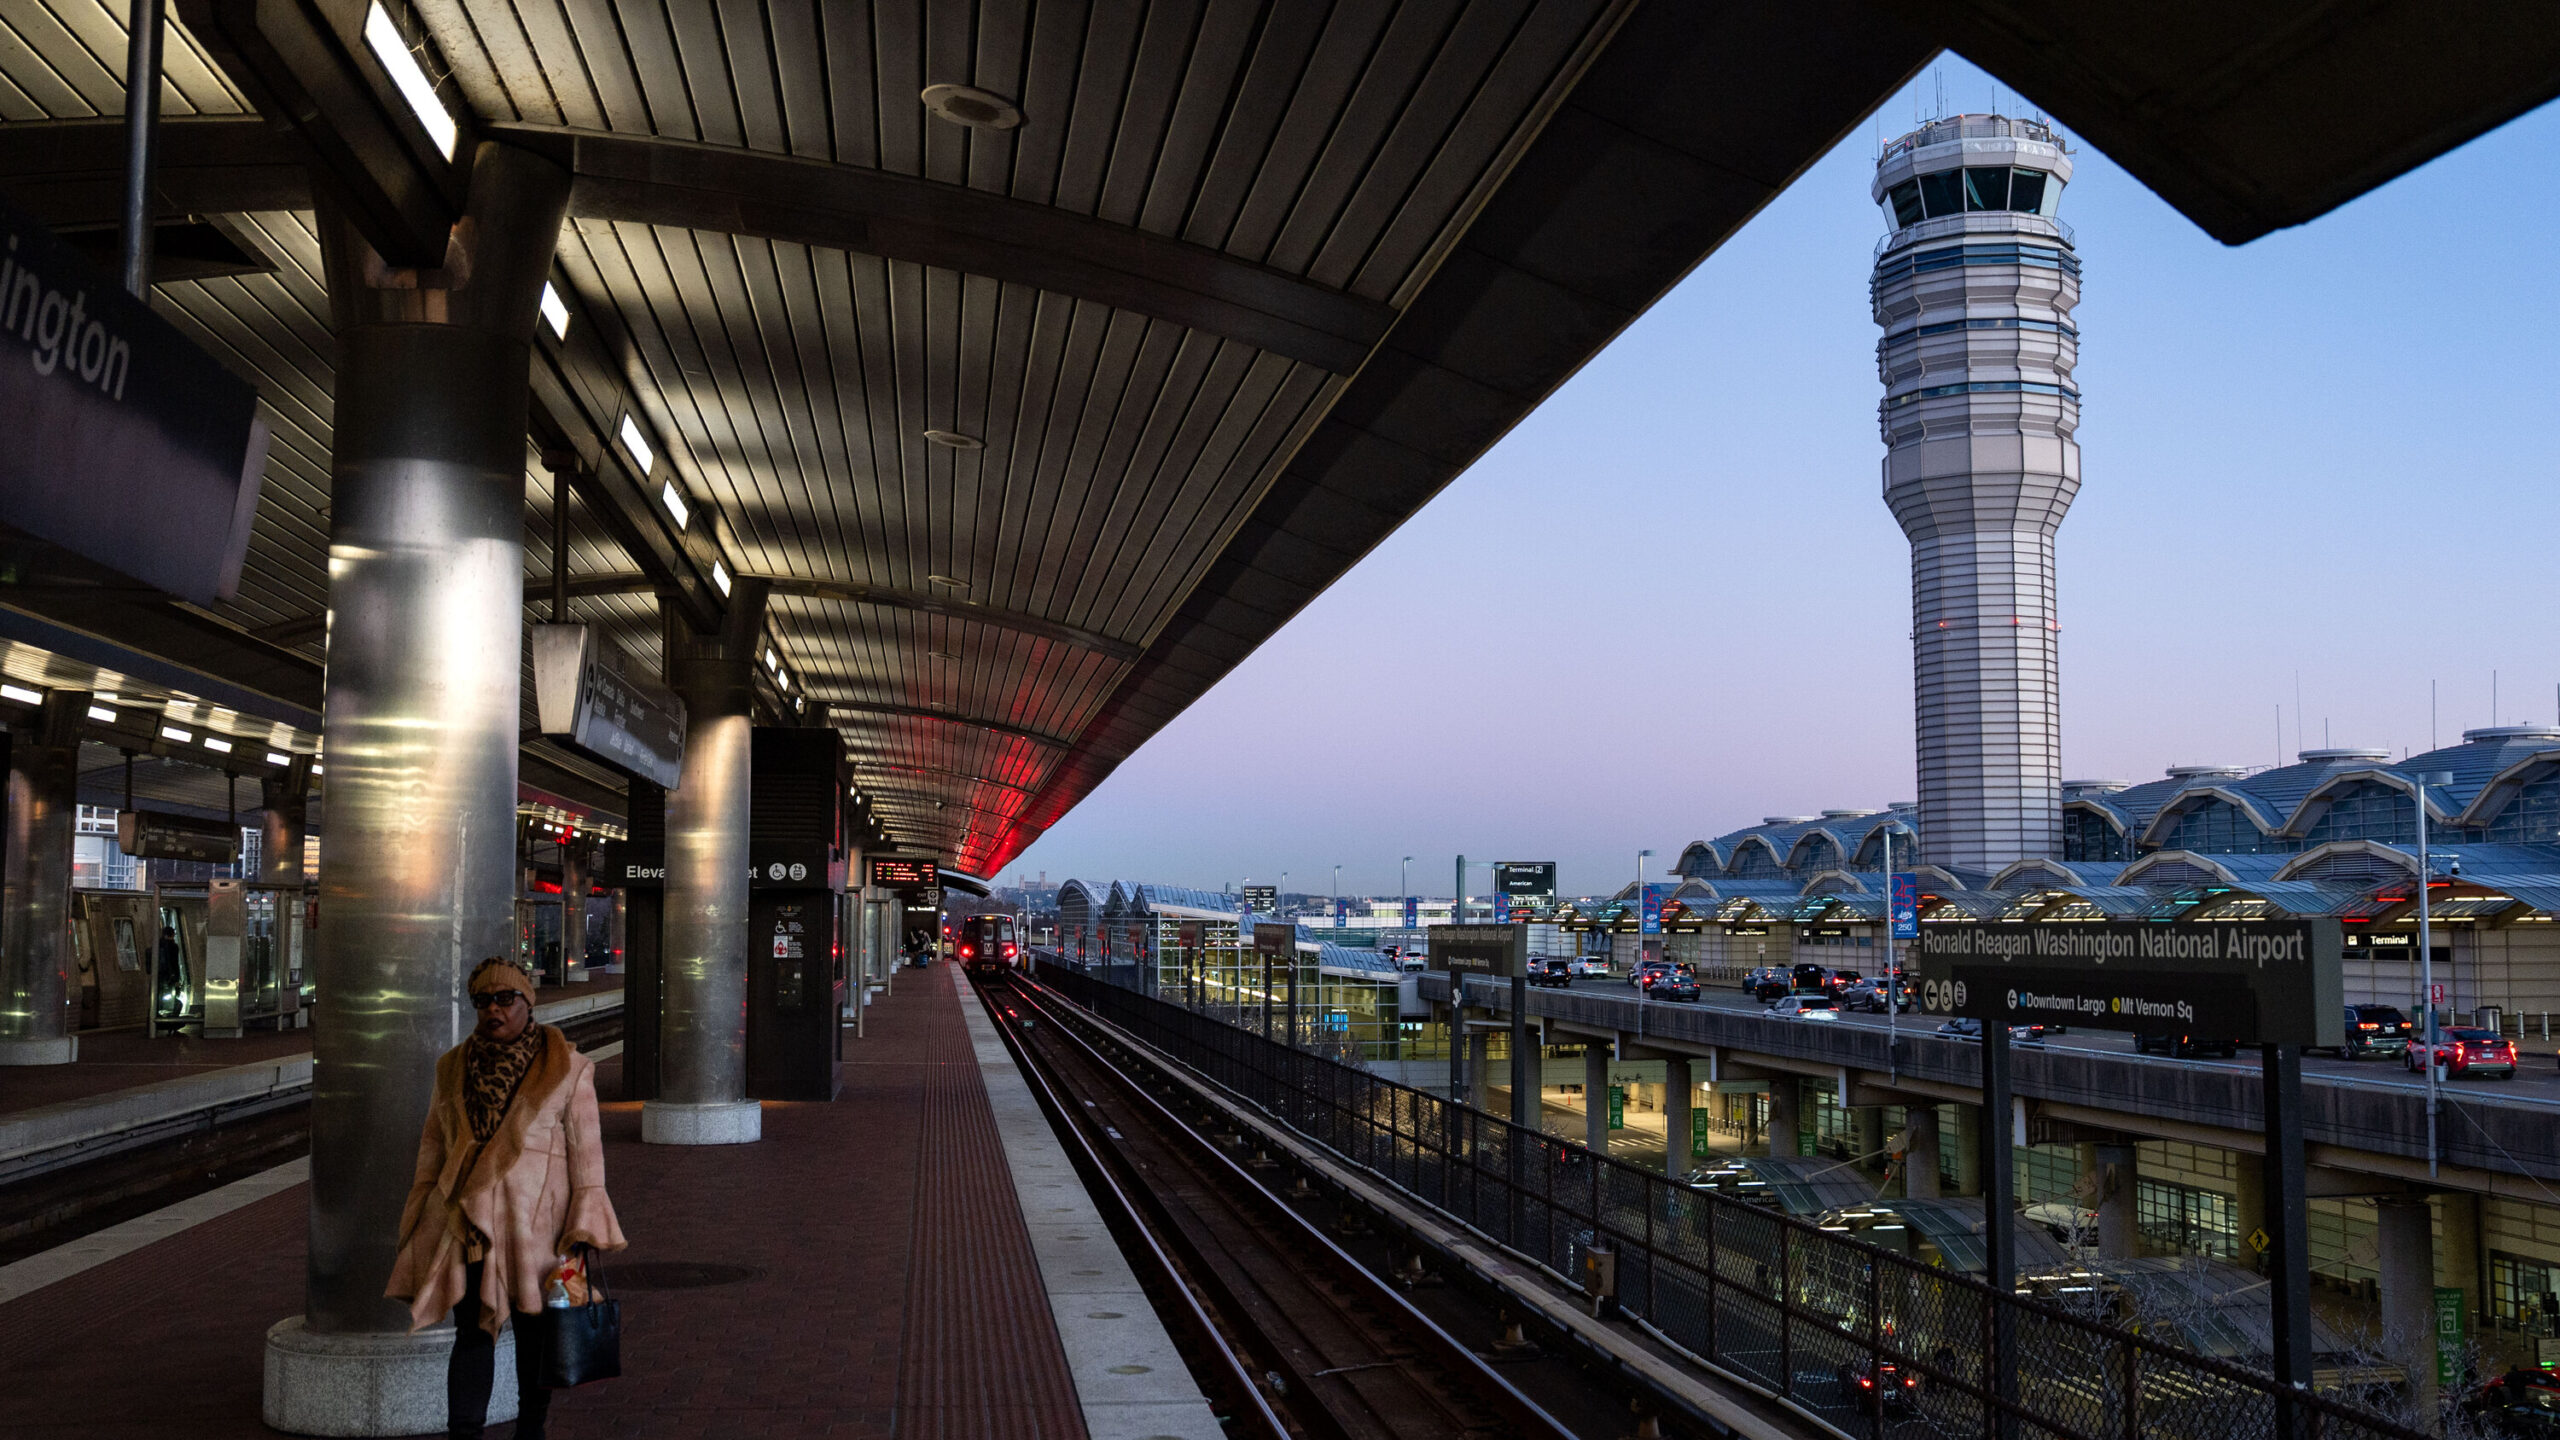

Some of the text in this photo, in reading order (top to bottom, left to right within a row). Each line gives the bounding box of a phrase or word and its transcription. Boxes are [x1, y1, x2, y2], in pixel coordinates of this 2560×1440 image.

[1897, 923, 1913, 931] 250
[2370, 934, 2409, 945] Terminal
[1924, 927, 2304, 969] Ronald Reagan Washington National Airport
[2026, 992, 2075, 1011] Downtown
[2077, 994, 2106, 1017] Largo
[2121, 997, 2134, 1015] Mt
[2135, 998, 2174, 1017] Vernon
[2177, 1000, 2193, 1023] Sq
[1612, 1115, 1621, 1127] 4
[1696, 1140, 1705, 1153] 4
